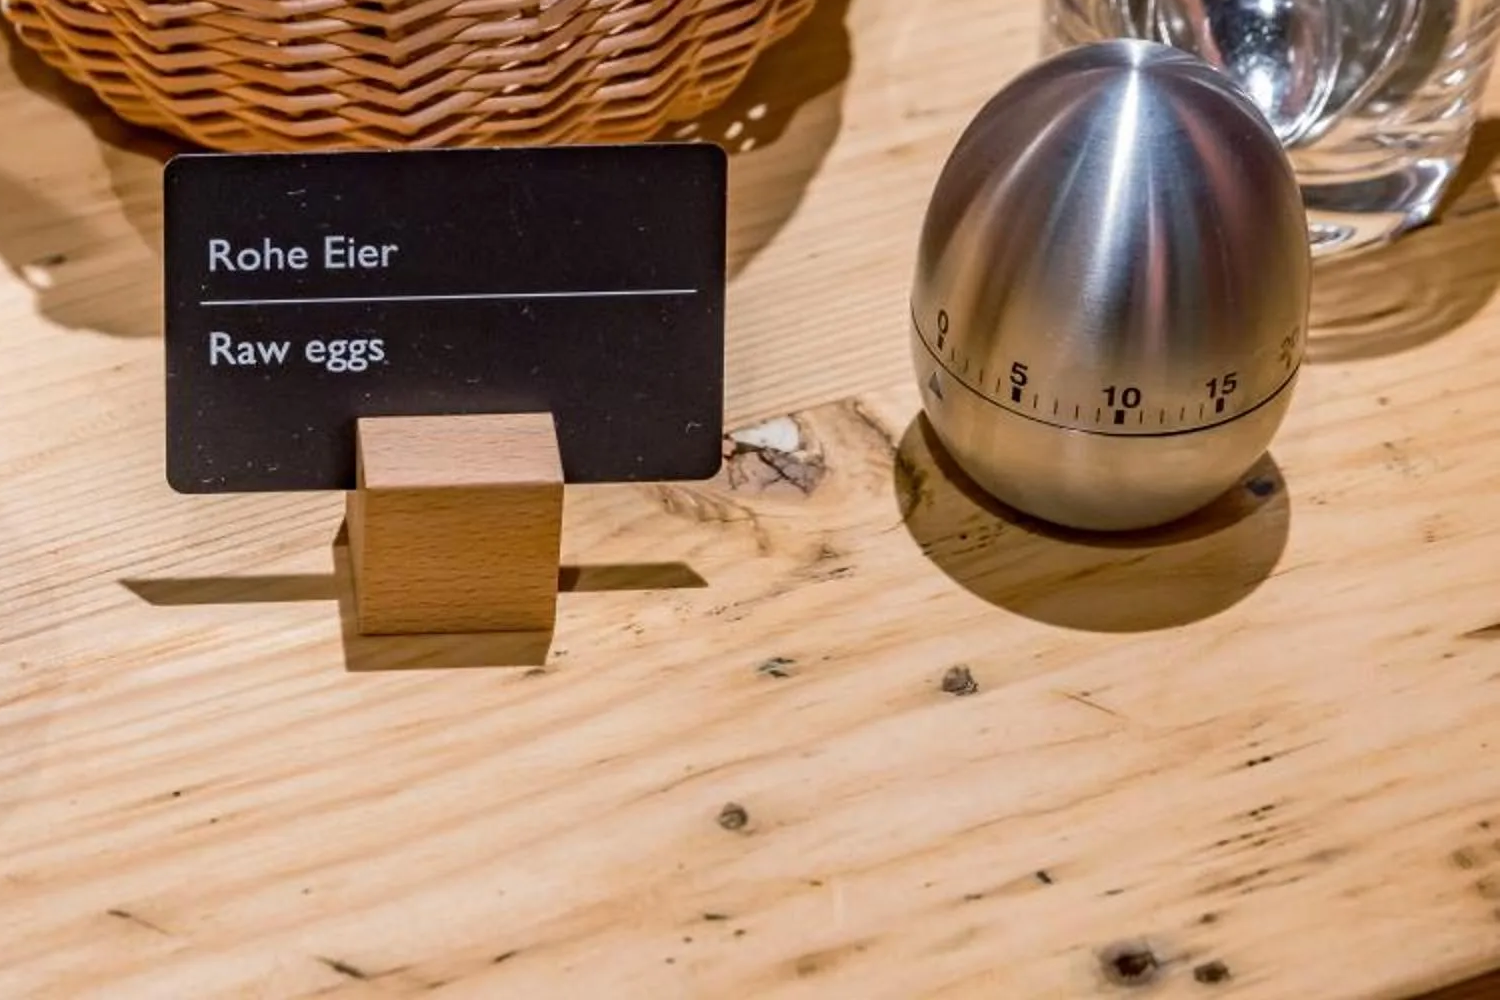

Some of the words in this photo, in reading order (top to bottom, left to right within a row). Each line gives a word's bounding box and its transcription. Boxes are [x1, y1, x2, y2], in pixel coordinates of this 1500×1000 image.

[209, 237, 309, 272] Rohe
[324, 235, 399, 269] Eier
[209, 332, 291, 366] Raw
[305, 338, 385, 373] eggs
[937, 309, 949, 334] 0
[1010, 361, 1029, 387] 5
[1102, 385, 1142, 409] 10
[1205, 372, 1238, 399] 15
